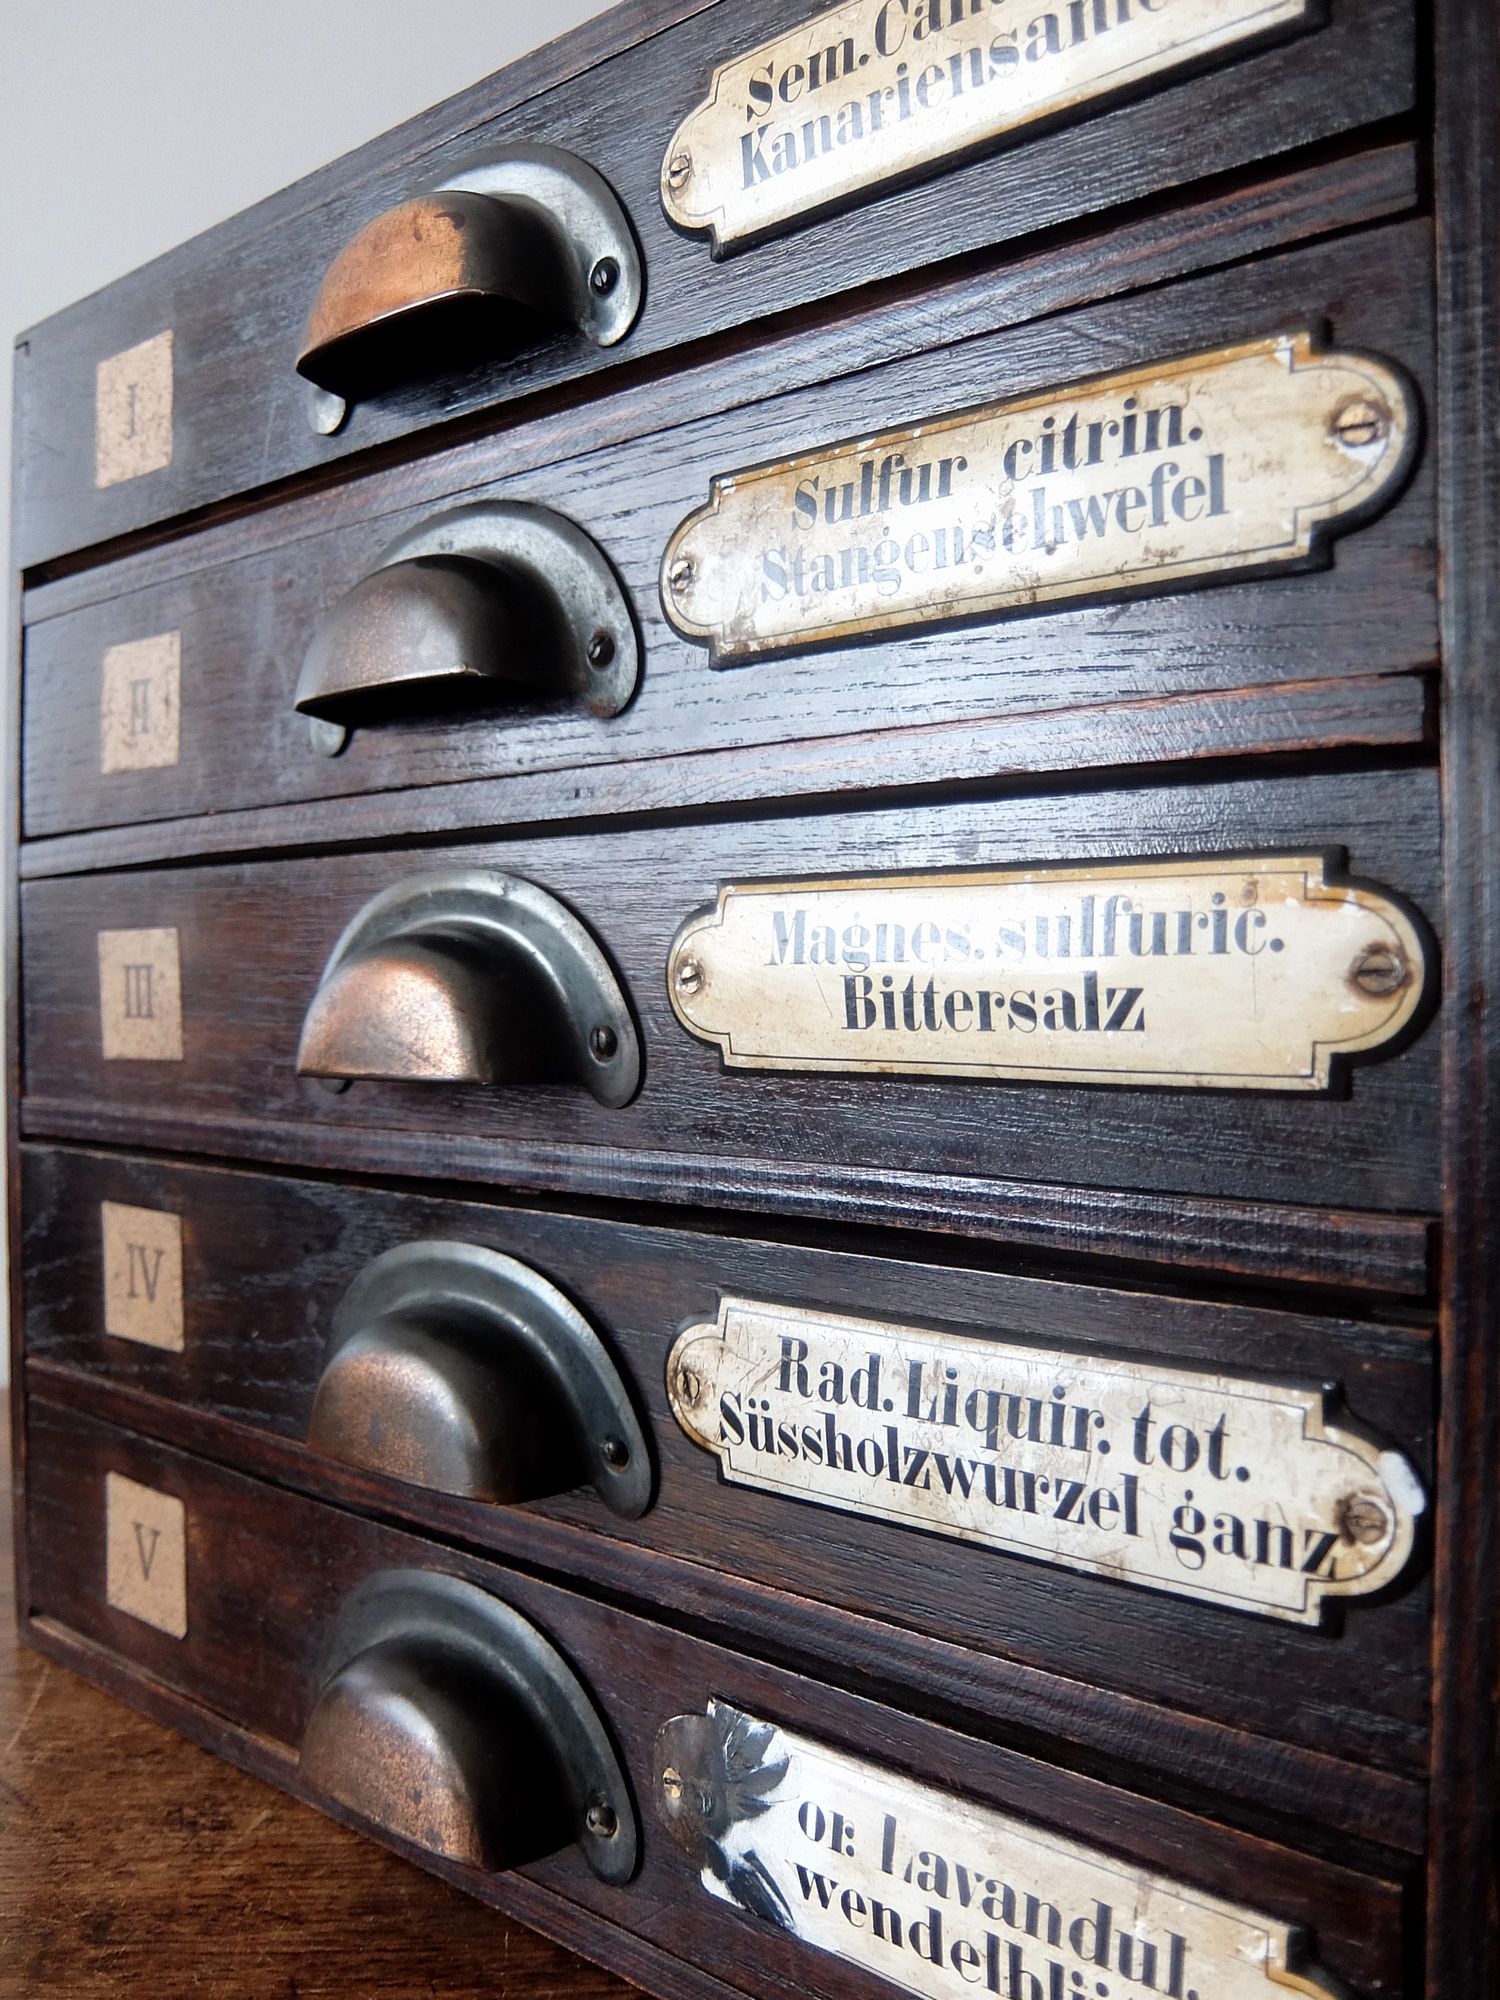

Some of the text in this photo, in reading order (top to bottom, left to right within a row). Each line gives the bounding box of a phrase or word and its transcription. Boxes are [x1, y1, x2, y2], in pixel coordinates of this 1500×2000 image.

[791, 397, 1204, 530] Sulfur citrin.
[761, 453, 1230, 604] Stangenschwefel
[128, 679, 152, 737] II
[767, 890, 1285, 970] Magnes. sulfuric.
[123, 964, 155, 1020] III
[841, 970, 1145, 1033] Bittersalz
[127, 1243, 165, 1303] IV
[776, 1335, 1251, 1482] Rad. Liquir. tot.
[718, 1391, 1339, 1580] Süssholzwurzel ganz
[132, 1522, 161, 1582] V
